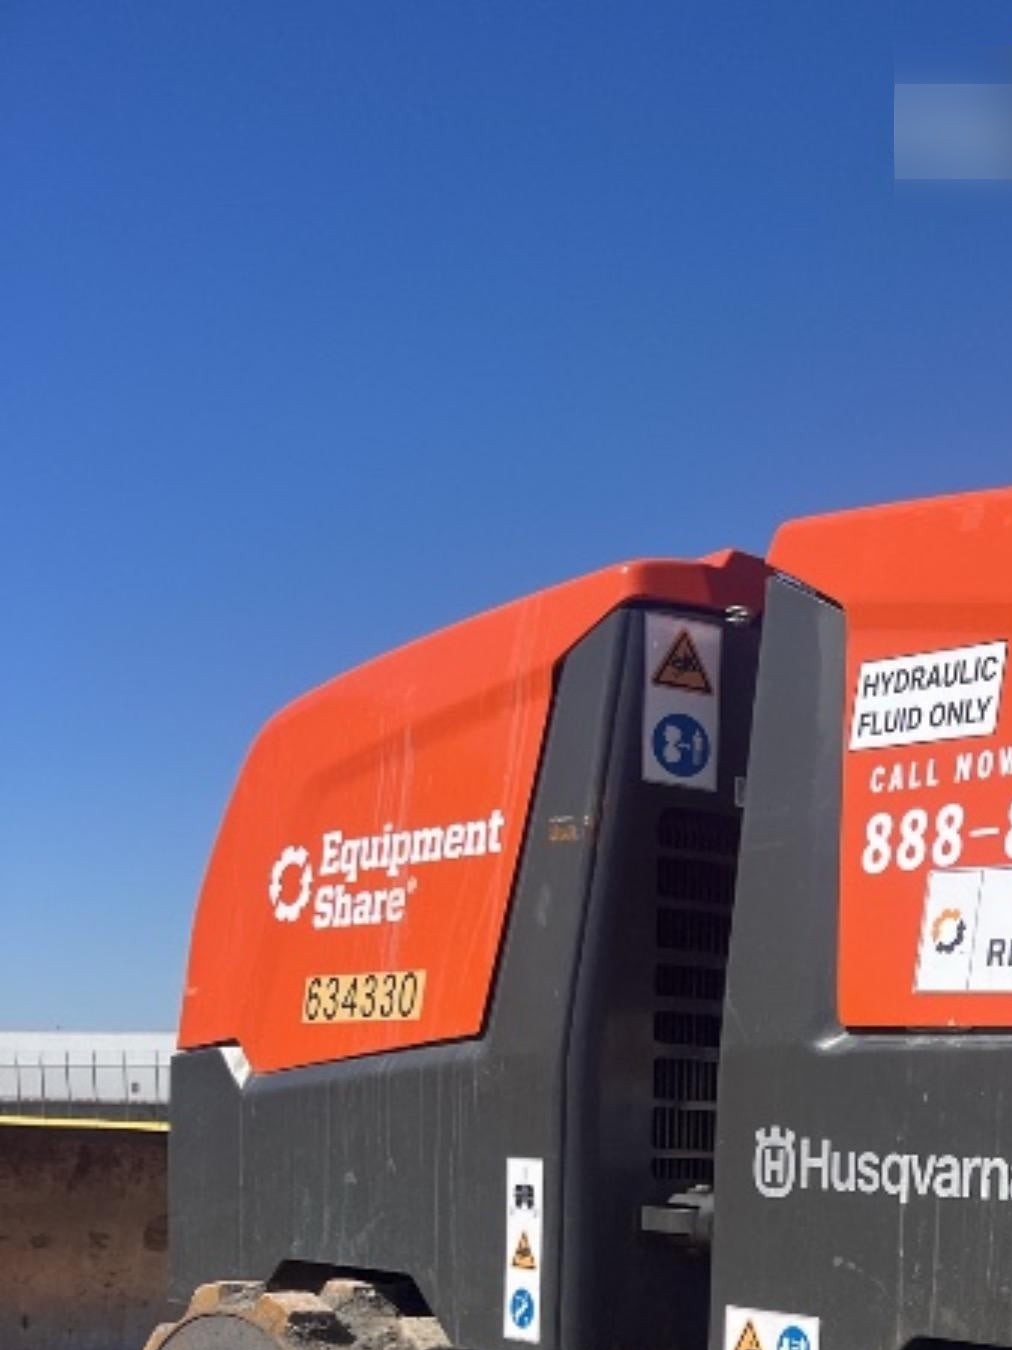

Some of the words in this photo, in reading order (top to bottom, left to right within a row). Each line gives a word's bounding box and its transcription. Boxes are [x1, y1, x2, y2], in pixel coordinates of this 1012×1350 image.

[862, 655, 999, 699] HYDRAULIC
[857, 706, 922, 739] FLUID
[929, 696, 993, 728] ONLY
[869, 758, 940, 793] CALL
[318, 809, 504, 883] Equipment
[305, 971, 418, 1021] 634330
